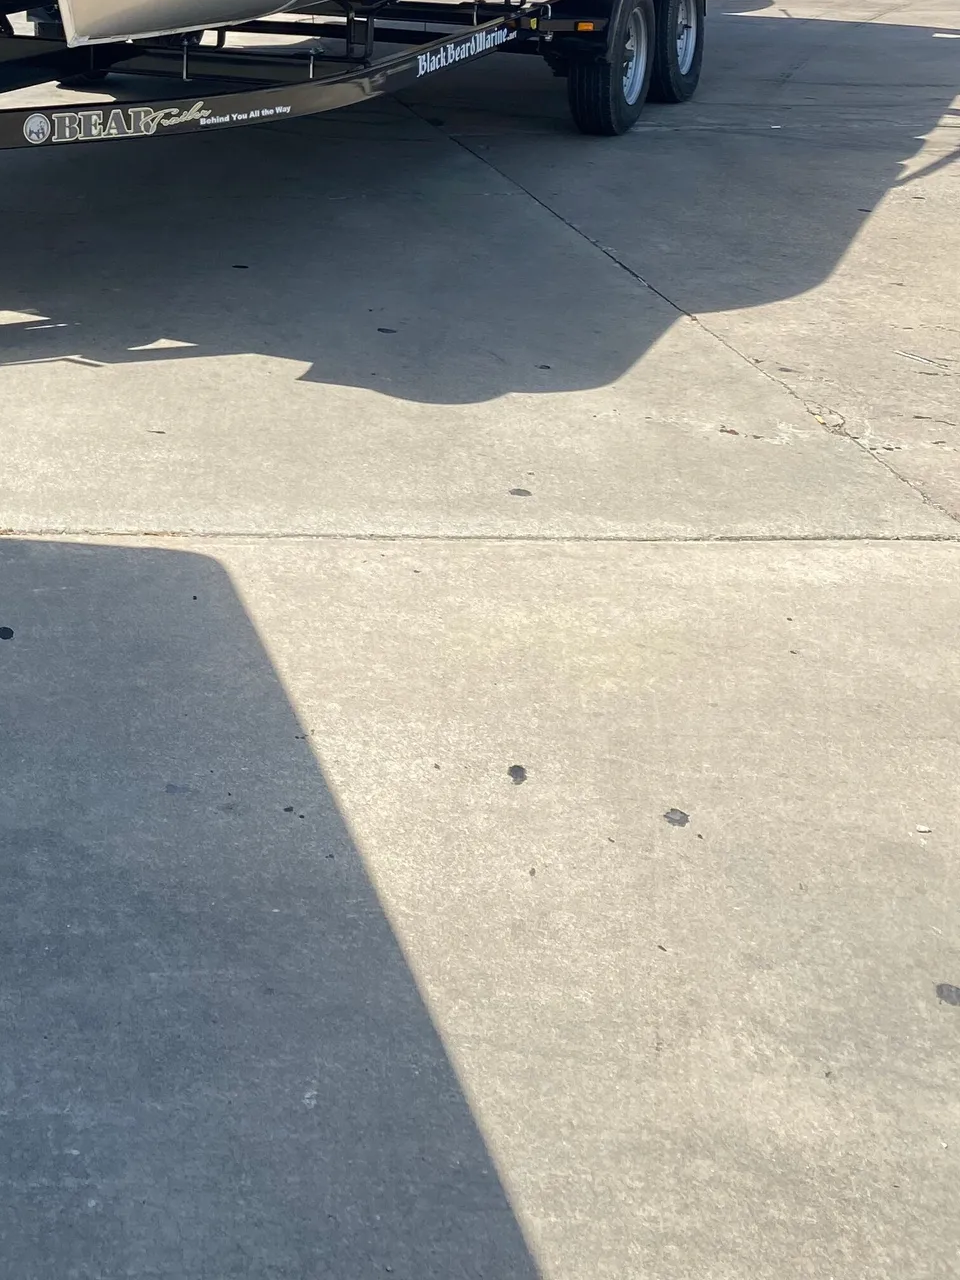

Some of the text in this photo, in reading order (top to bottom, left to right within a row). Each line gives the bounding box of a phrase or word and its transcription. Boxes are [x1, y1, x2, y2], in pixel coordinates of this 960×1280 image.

[139, 101, 212, 135] Trailer
[200, 105, 292, 125] Behind You All the Way
